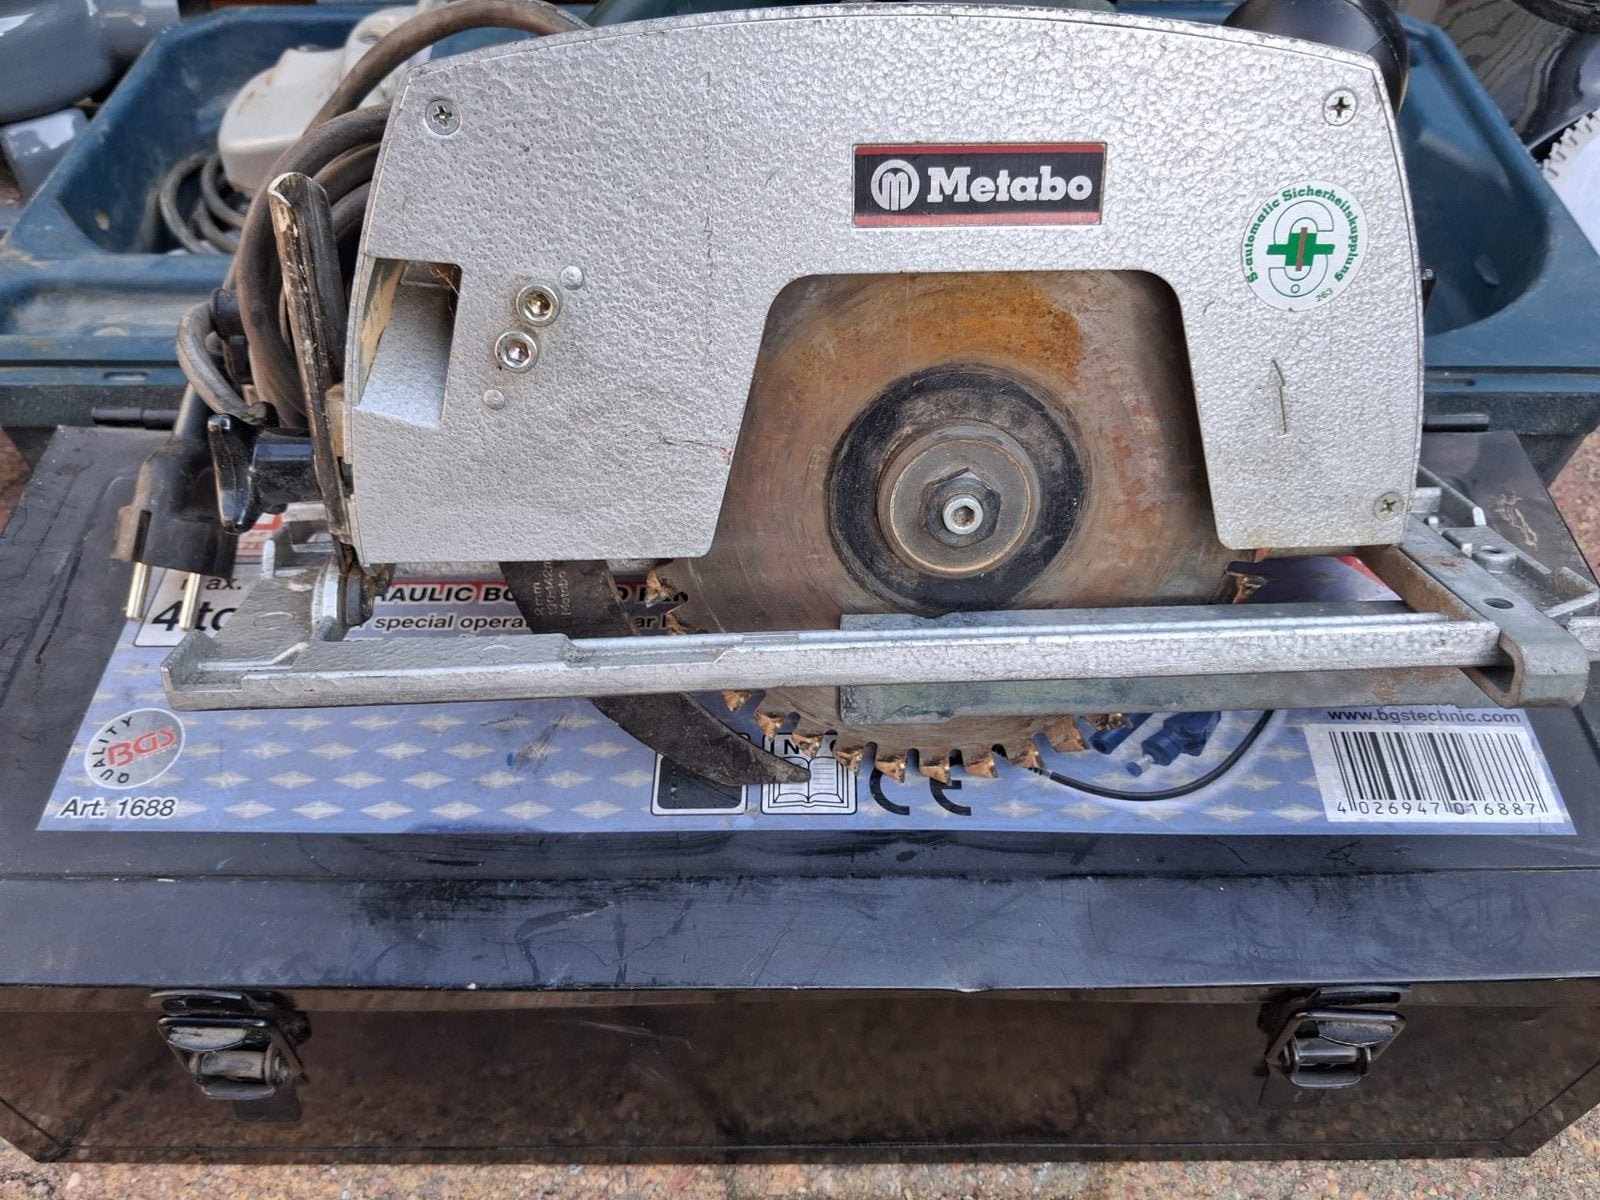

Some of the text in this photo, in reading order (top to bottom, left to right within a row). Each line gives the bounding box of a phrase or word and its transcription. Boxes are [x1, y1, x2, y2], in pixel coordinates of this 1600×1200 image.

[926, 165, 1093, 203] Metabo
[1243, 185, 1358, 284] S-automatic Sicherheitskupplung
[1315, 287, 1334, 303] 263
[379, 586, 477, 602] AULIC
[374, 615, 528, 631] special opera
[1327, 708, 1521, 725] www.bgstechnic.com
[92, 716, 133, 784] QUALITY
[106, 727, 177, 768] BGS
[60, 799, 176, 817] Art. 1688
